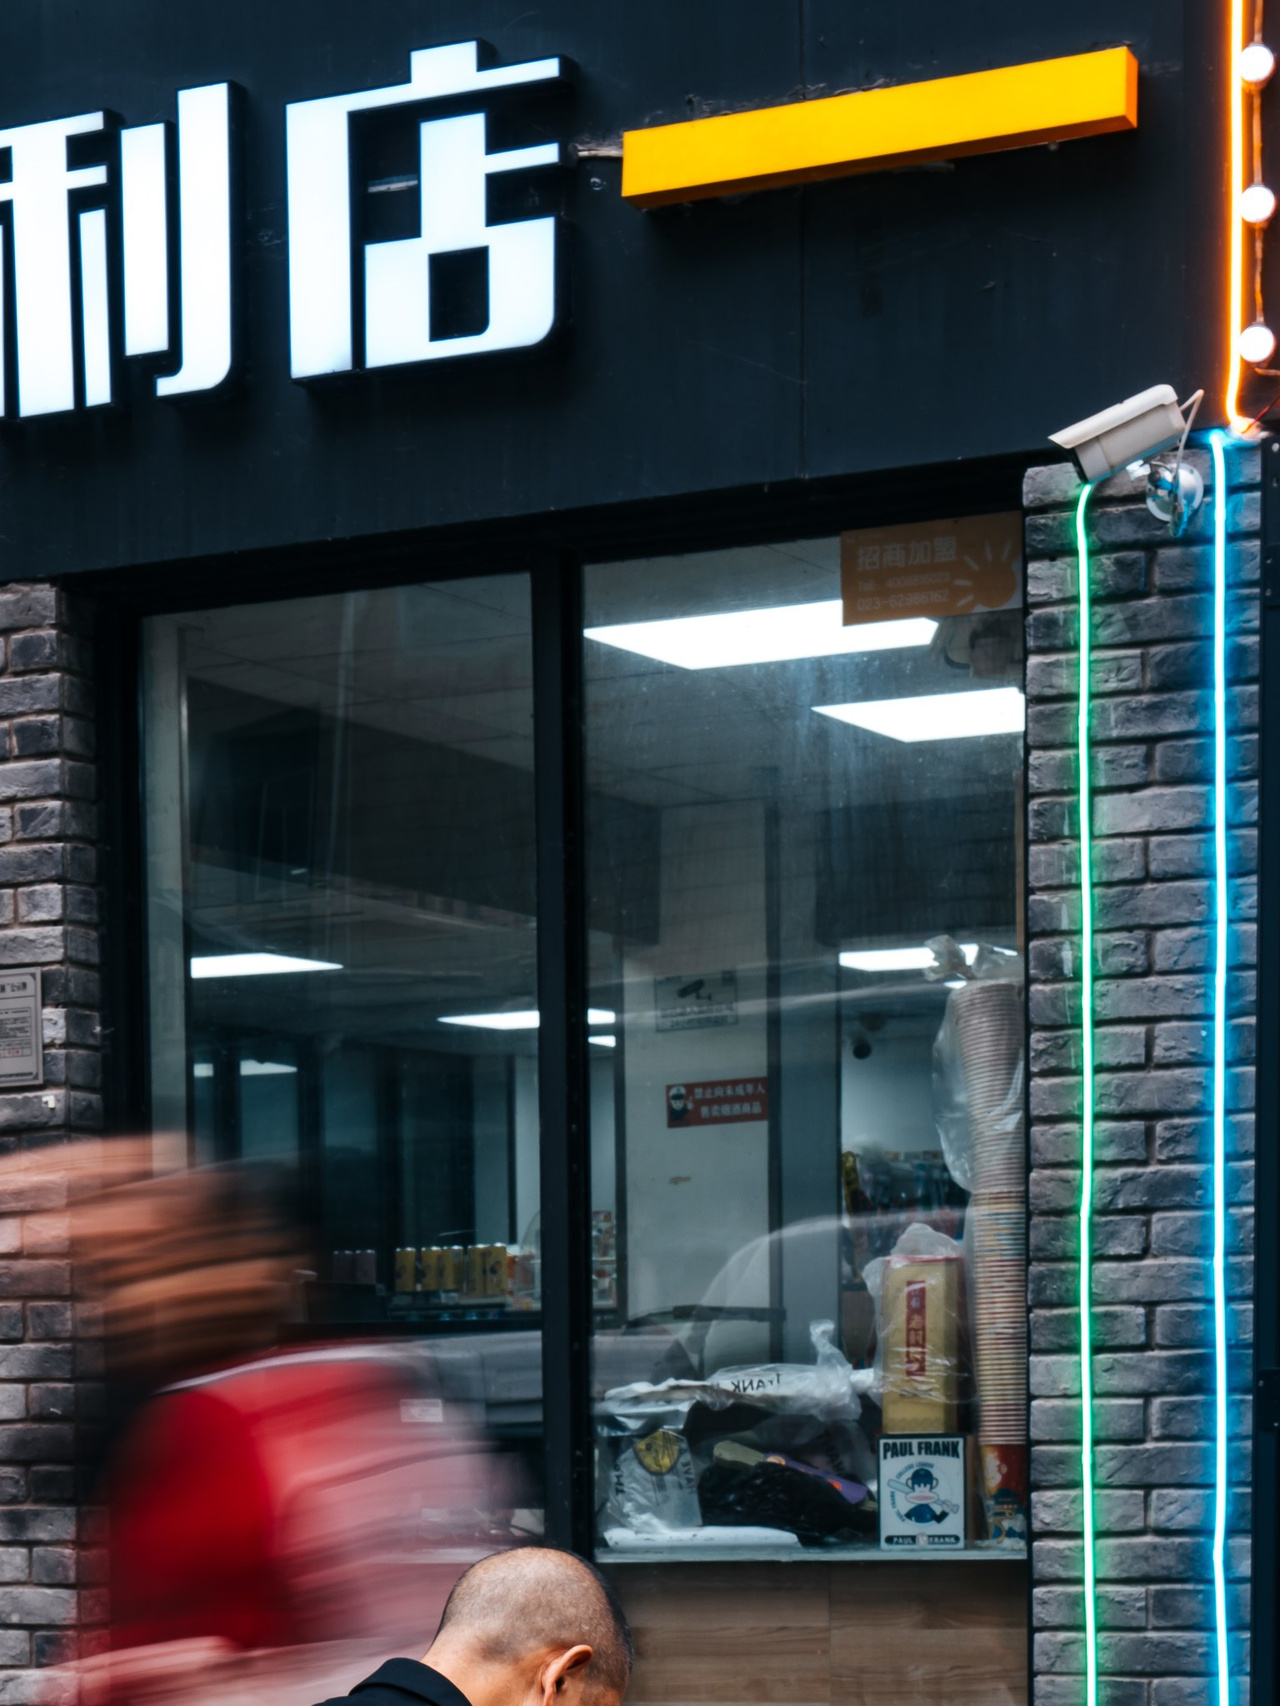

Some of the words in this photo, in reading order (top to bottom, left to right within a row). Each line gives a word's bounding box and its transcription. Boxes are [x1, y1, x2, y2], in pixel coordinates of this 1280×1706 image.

[857, 536, 957, 571] 招商加盟
[694, 1082, 766, 1100] 禁止向未成年人
[883, 1442, 914, 1460] PAUL
[917, 1440, 961, 1459] FRANK
[893, 1537, 914, 1545] PAUL
[929, 1536, 956, 1544] FRANK
